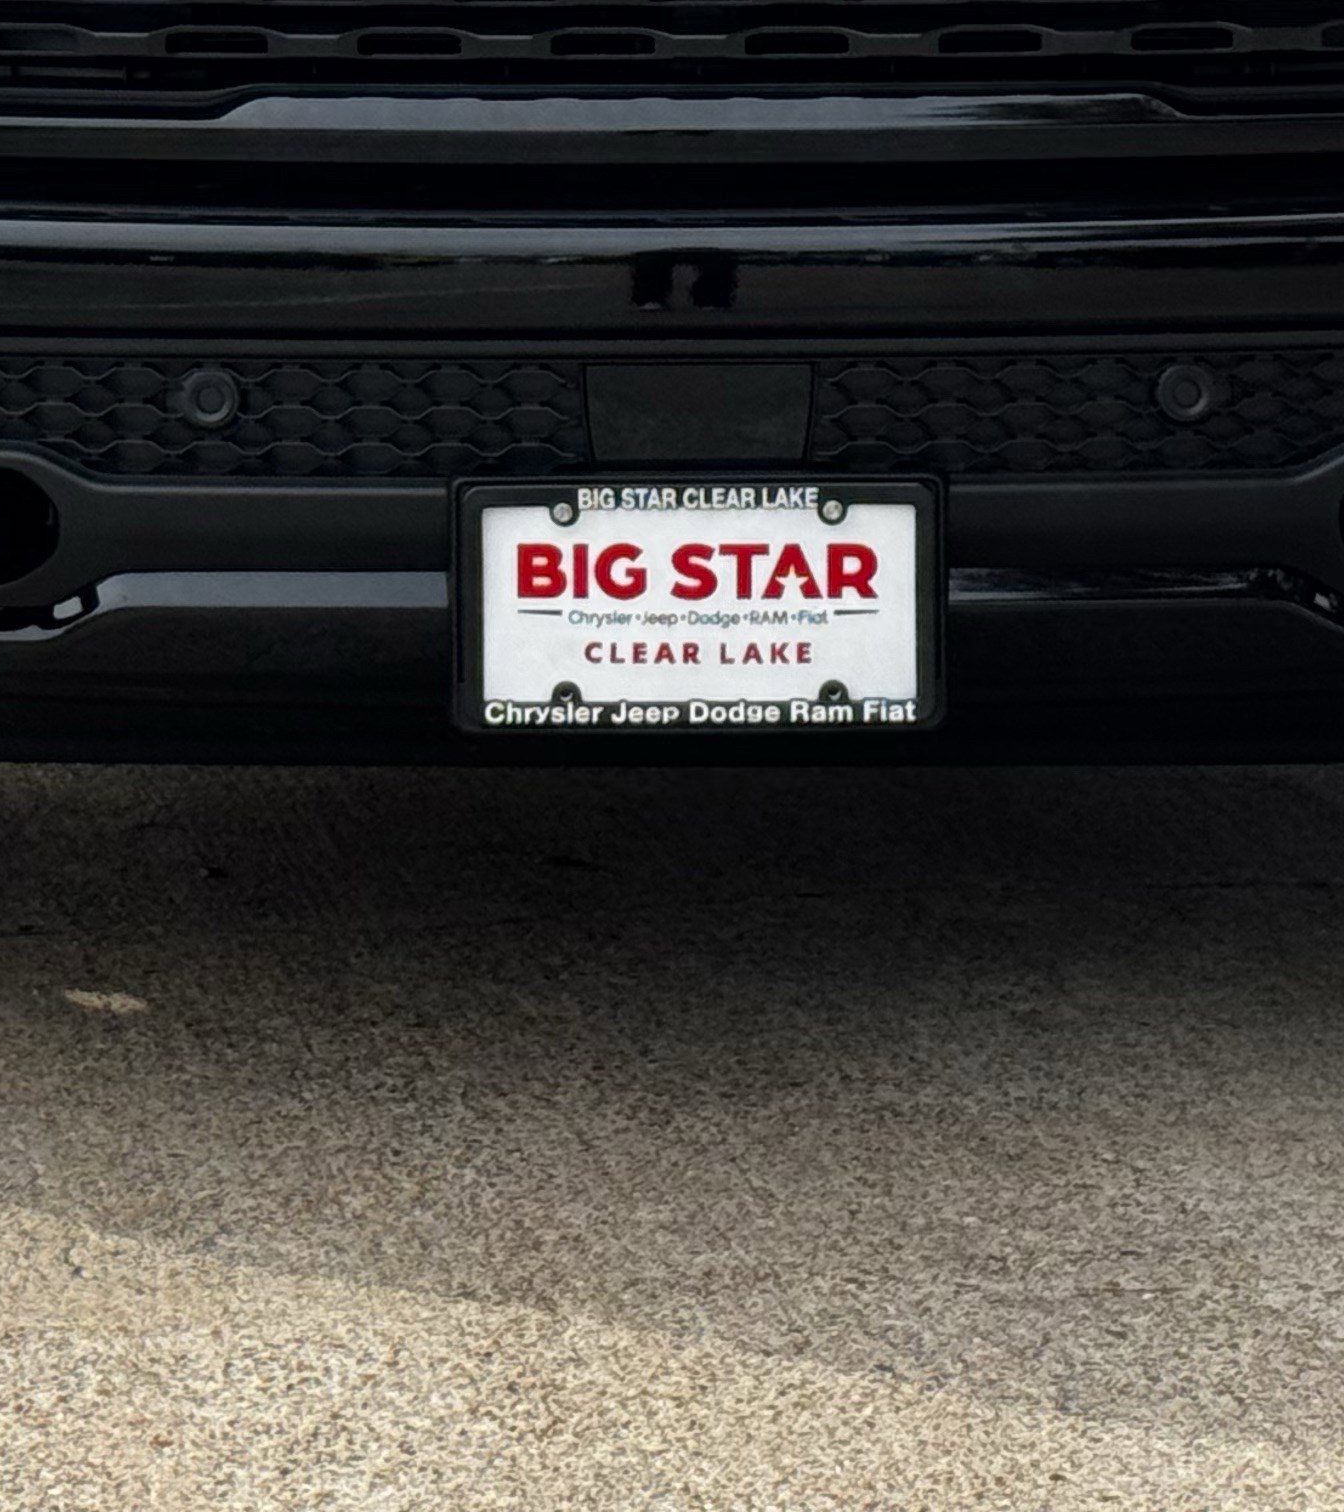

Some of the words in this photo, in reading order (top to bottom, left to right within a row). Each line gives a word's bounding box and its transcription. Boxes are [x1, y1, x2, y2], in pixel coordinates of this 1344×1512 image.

[577, 487, 616, 510] BIG
[620, 487, 677, 510] STAR
[682, 487, 756, 510] CLEAR
[759, 486, 819, 510] LAKE
[517, 543, 647, 601] BIG
[670, 543, 878, 601] STAR
[584, 641, 701, 665] CLEAR
[719, 641, 812, 665] LAKE
[484, 701, 604, 726] Chrysler
[611, 701, 680, 725] Jeep
[689, 701, 781, 724] Dodge
[790, 701, 854, 724] Ram
[863, 699, 916, 723] Fiat
